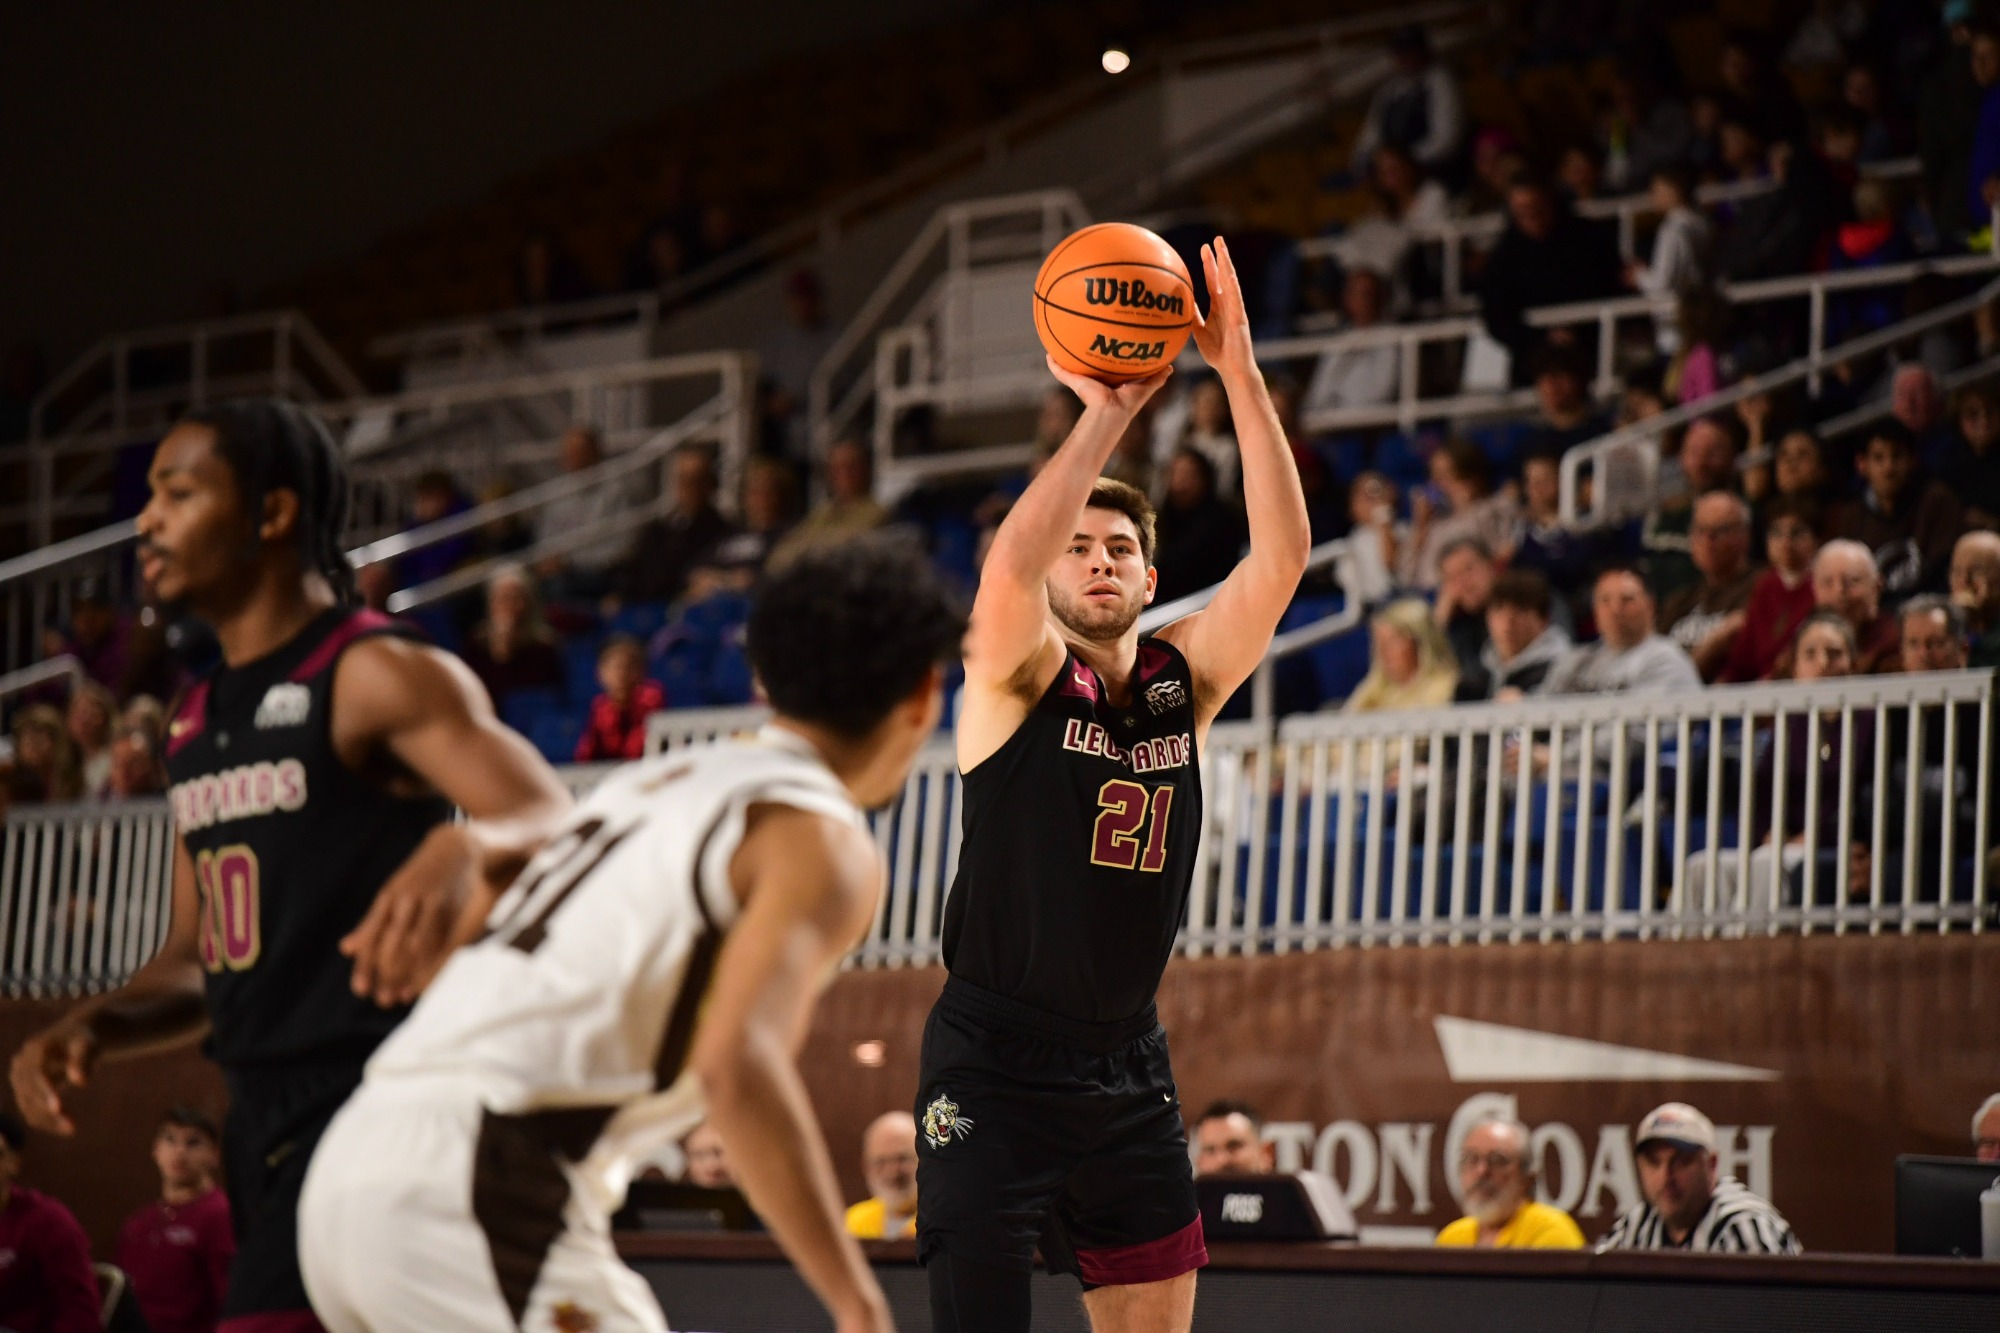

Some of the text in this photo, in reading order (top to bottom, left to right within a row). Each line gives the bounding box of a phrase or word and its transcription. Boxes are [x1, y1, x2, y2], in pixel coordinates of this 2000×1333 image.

[1084, 278, 1184, 316] Wilson
[1089, 333, 1166, 360] NCAA
[1090, 778, 1174, 873] 21
[1443, 1091, 1775, 1217] COAH
